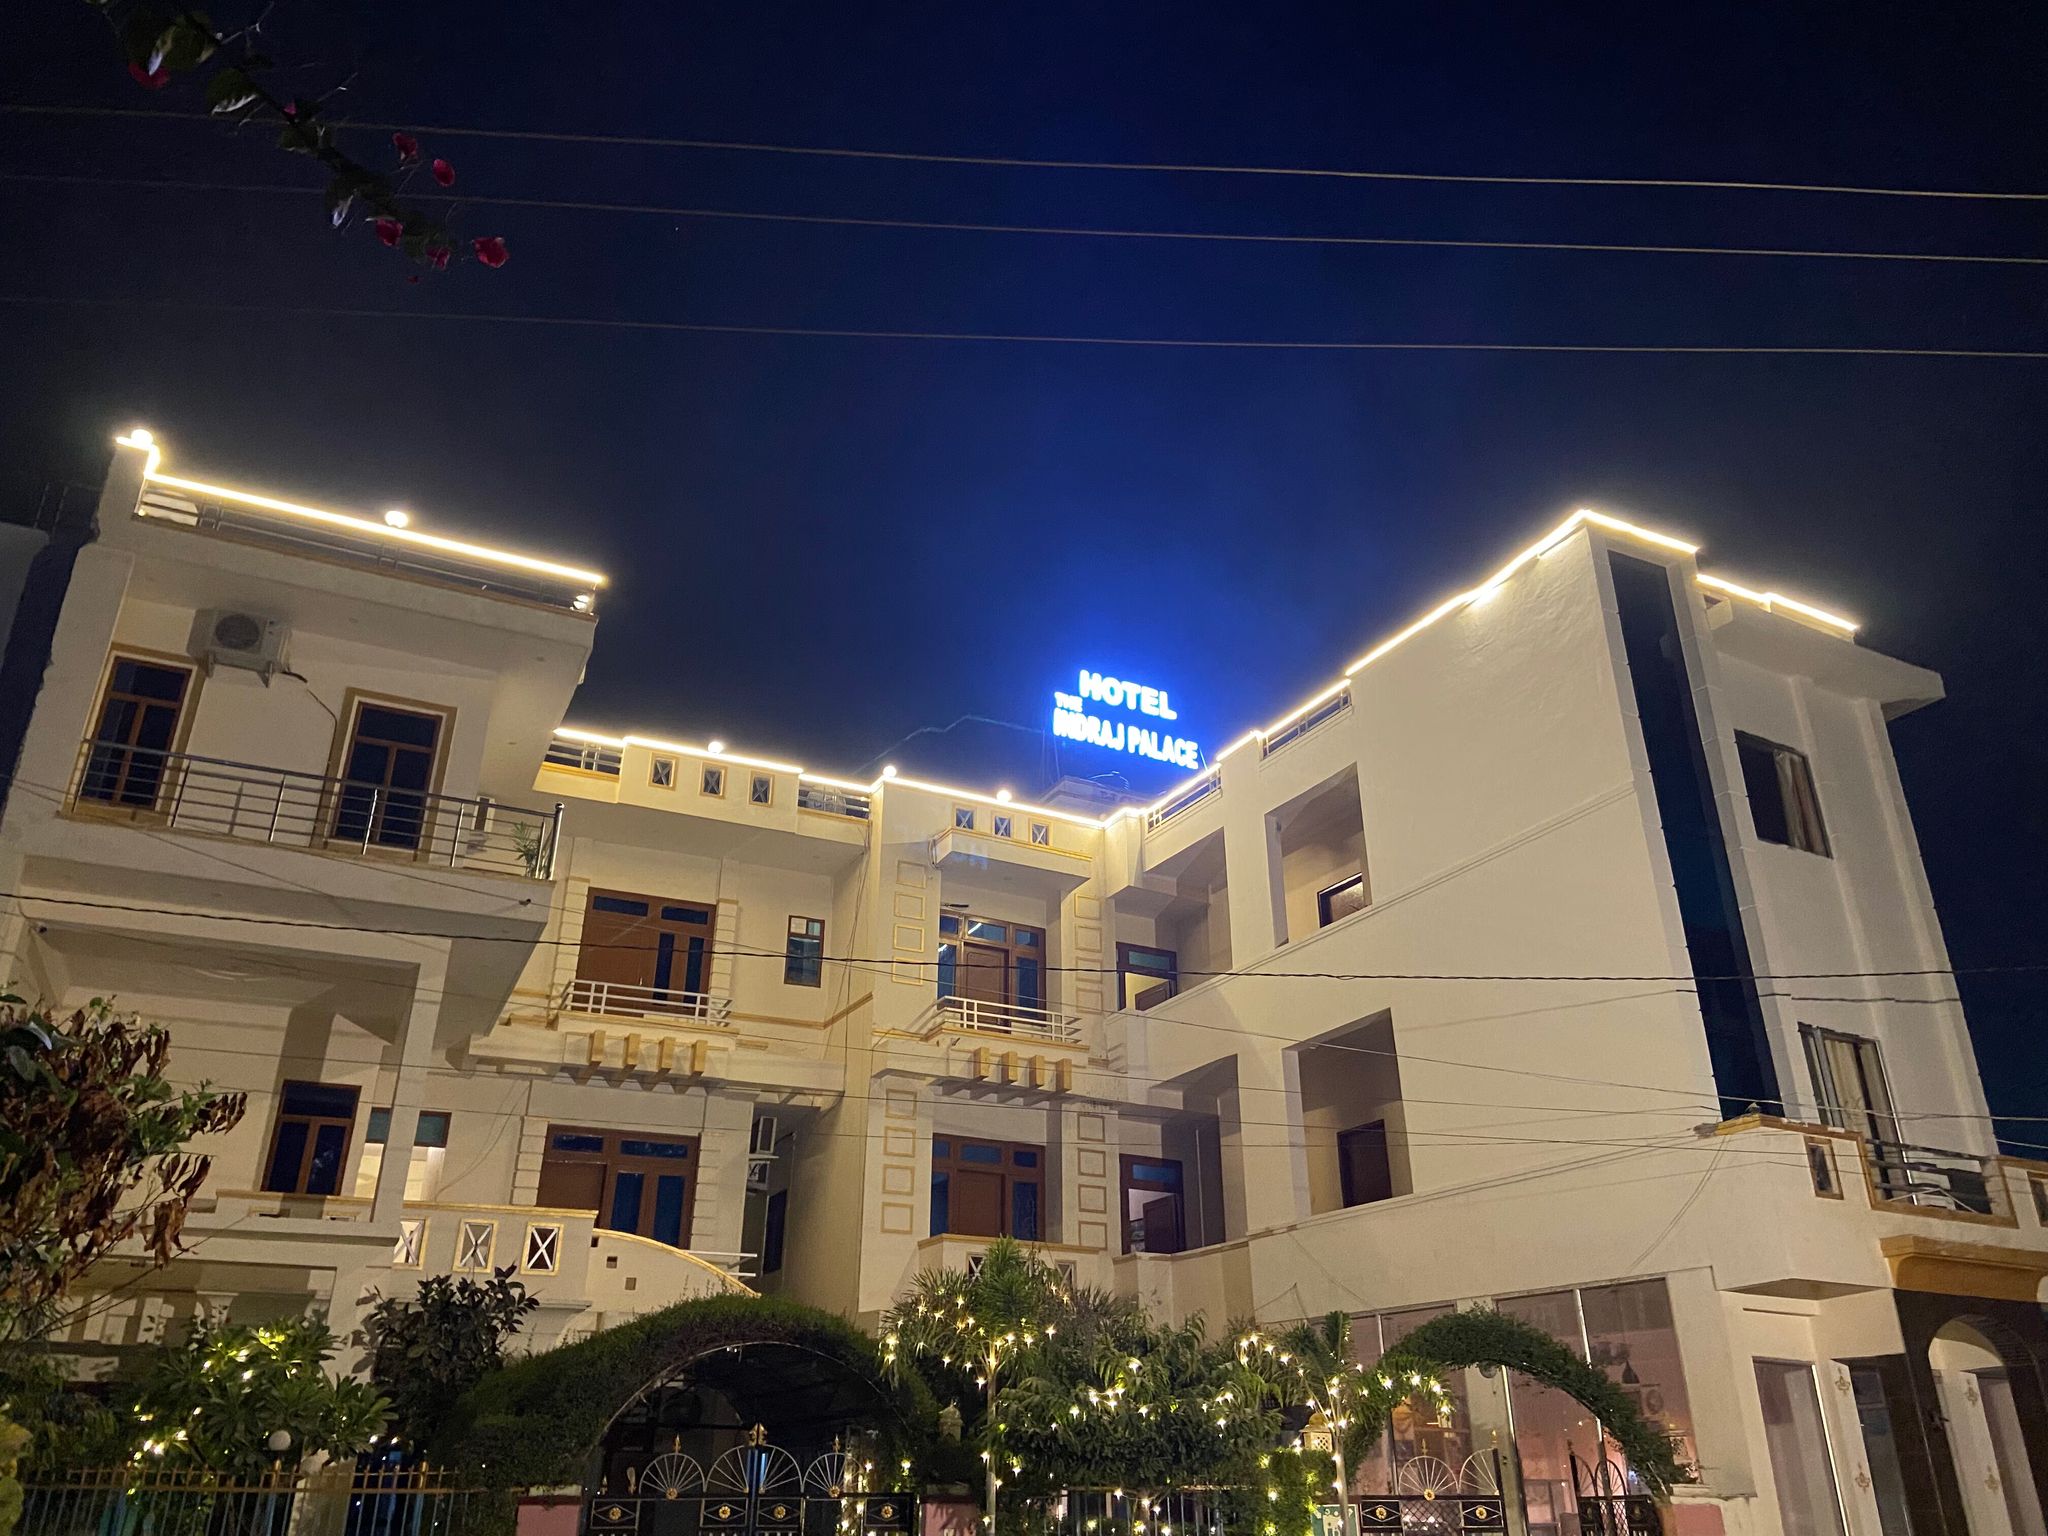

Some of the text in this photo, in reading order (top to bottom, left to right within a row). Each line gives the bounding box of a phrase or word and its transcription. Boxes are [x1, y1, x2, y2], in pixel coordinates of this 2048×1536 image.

[1054, 692, 1083, 713] THE
[1079, 669, 1177, 720] HOTEL
[1053, 707, 1199, 770] INDRAJ PALACE
